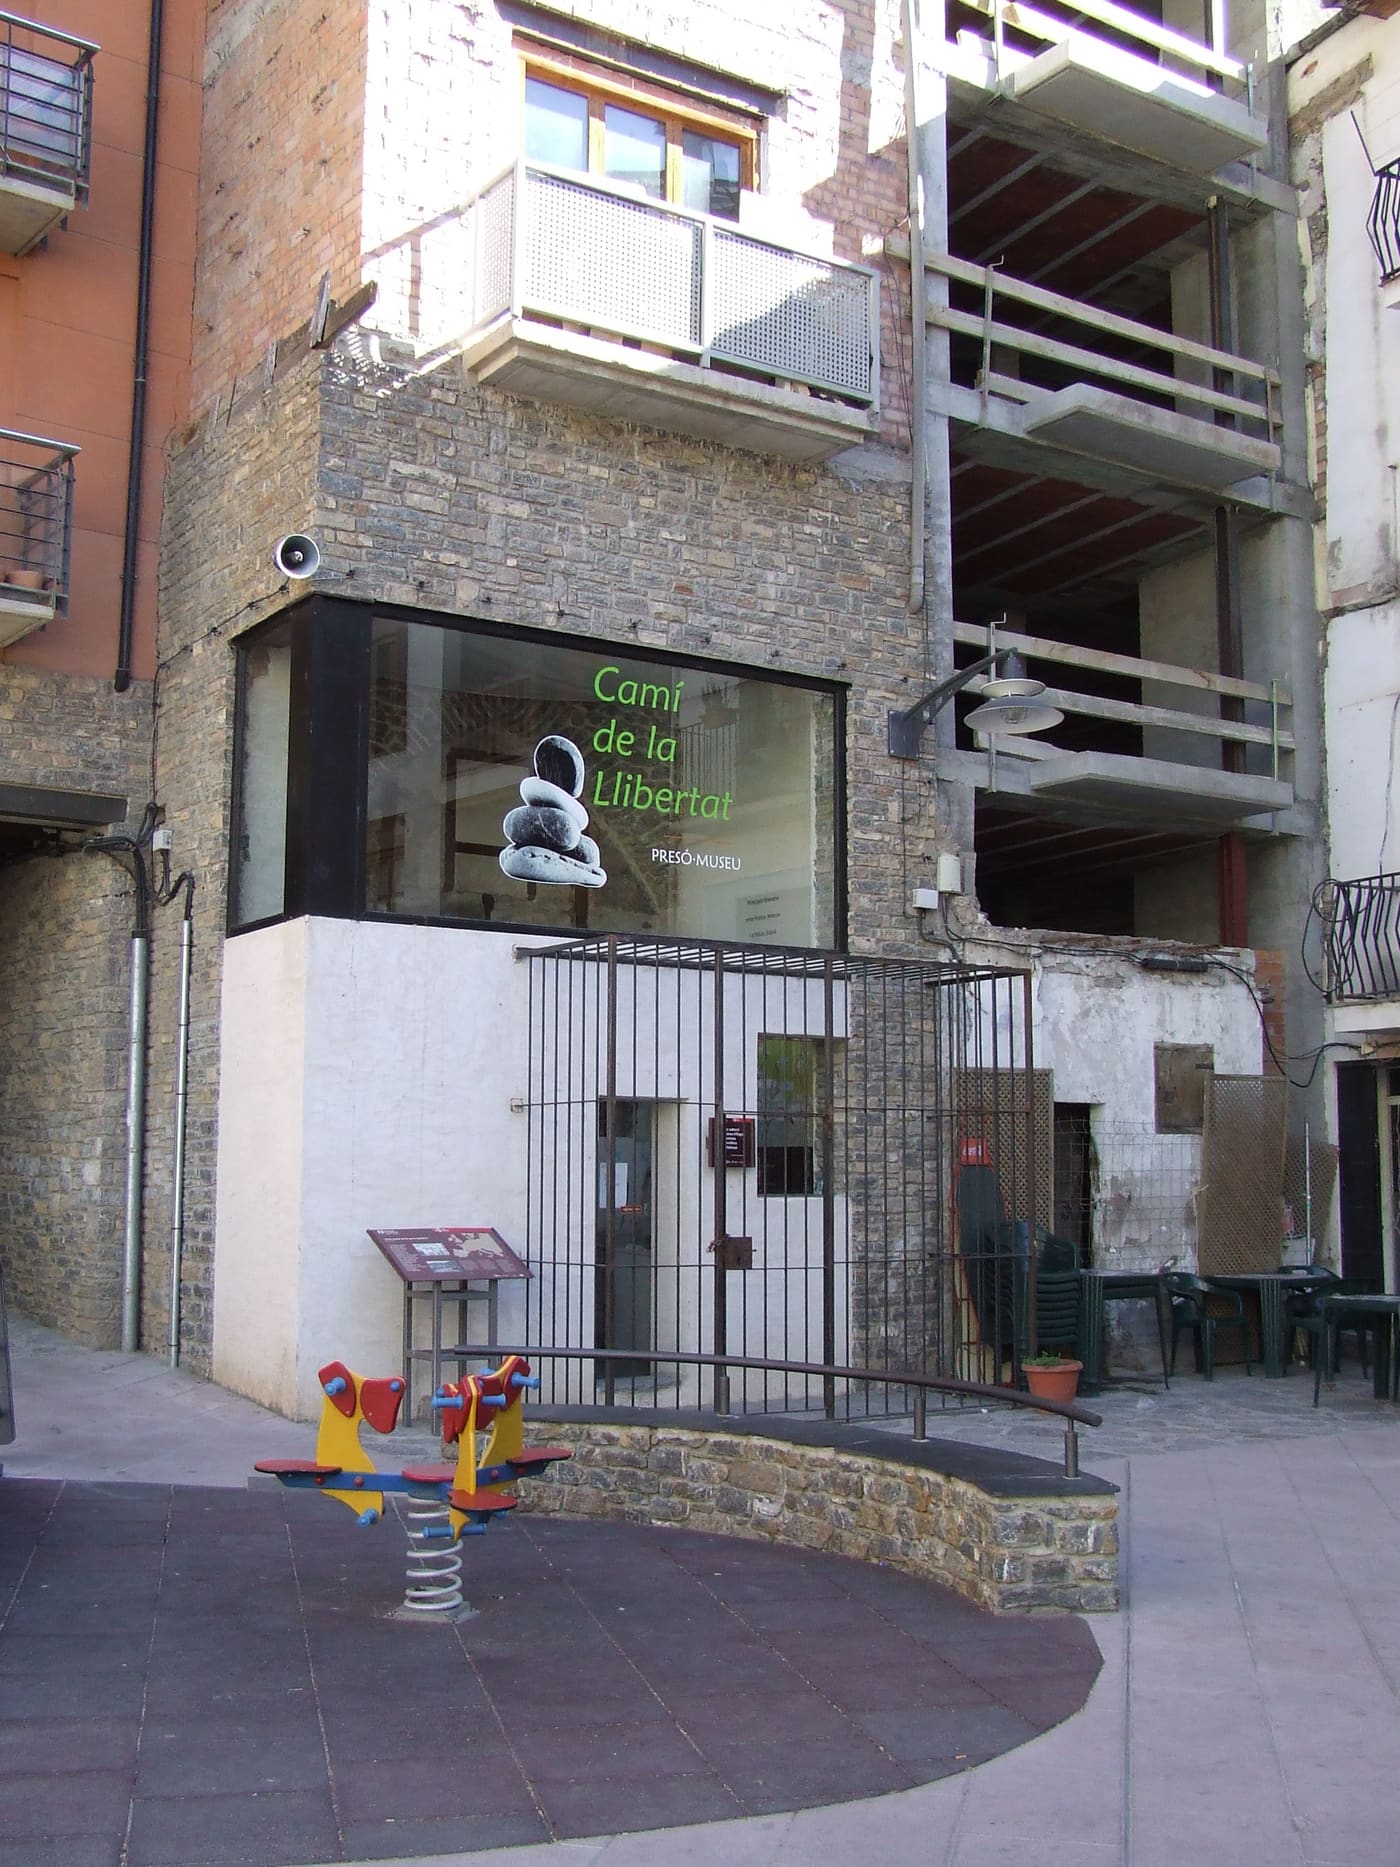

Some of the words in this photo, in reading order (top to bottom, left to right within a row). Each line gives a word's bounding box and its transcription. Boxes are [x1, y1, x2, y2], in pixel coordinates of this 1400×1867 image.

[593, 666, 684, 712] Camí
[592, 719, 635, 757] de
[647, 725, 678, 762] la
[593, 771, 733, 821] Llibertat
